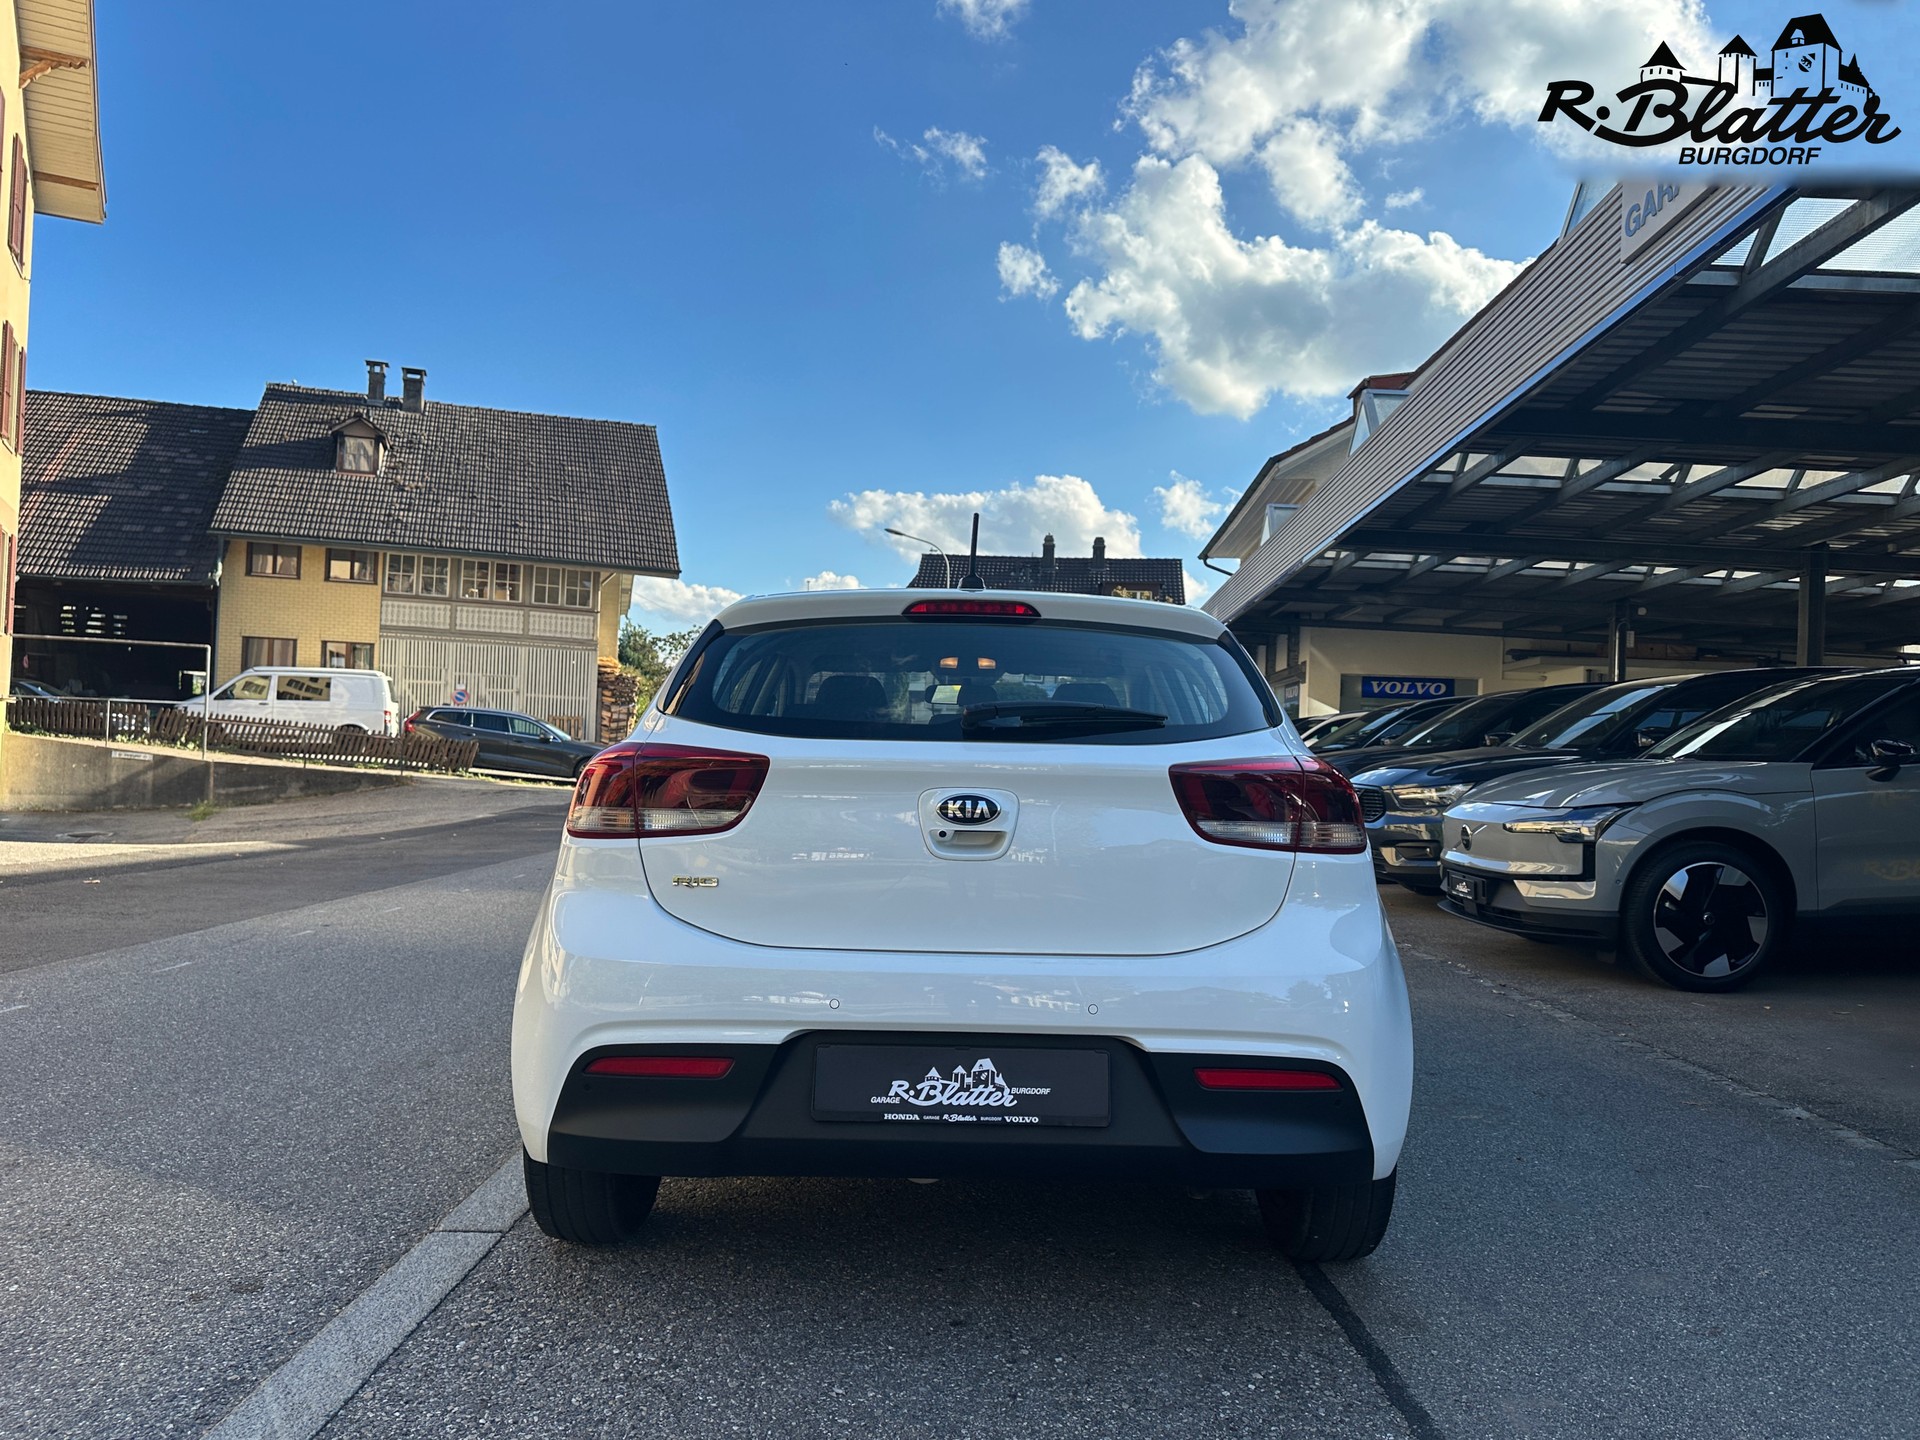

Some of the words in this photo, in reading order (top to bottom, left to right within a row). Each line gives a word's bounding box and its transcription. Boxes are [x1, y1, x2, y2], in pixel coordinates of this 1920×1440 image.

[1370, 681, 1447, 696] VOLVO
[947, 800, 991, 819] KIA
[672, 875, 720, 889] RIO
[870, 1096, 901, 1104] GARAGE
[1010, 1087, 1052, 1095] BURGDORF
[883, 1113, 920, 1121] HONDA
[1004, 1115, 1039, 1124] VOLVO
